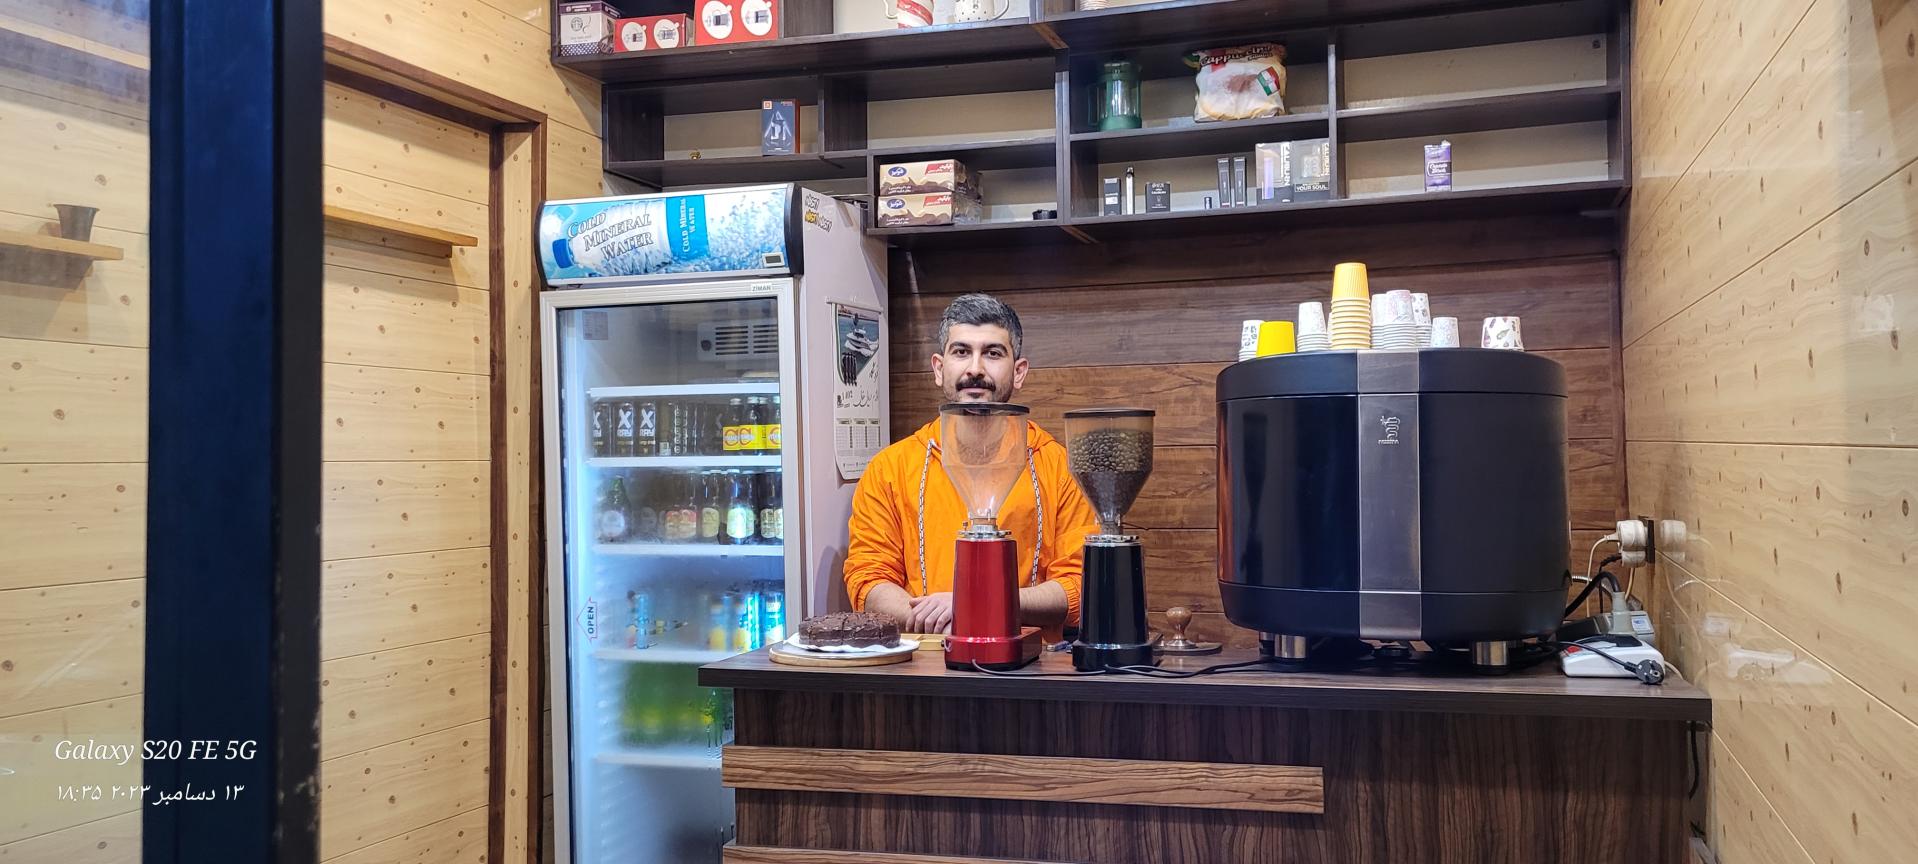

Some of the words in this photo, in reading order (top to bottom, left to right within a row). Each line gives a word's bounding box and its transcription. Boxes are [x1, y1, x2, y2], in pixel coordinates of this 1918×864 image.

[567, 212, 607, 239] COLD
[583, 213, 652, 252] MINERAL
[601, 231, 654, 262] WATER
[682, 229, 691, 252] COLD
[587, 606, 595, 634] OPEN
